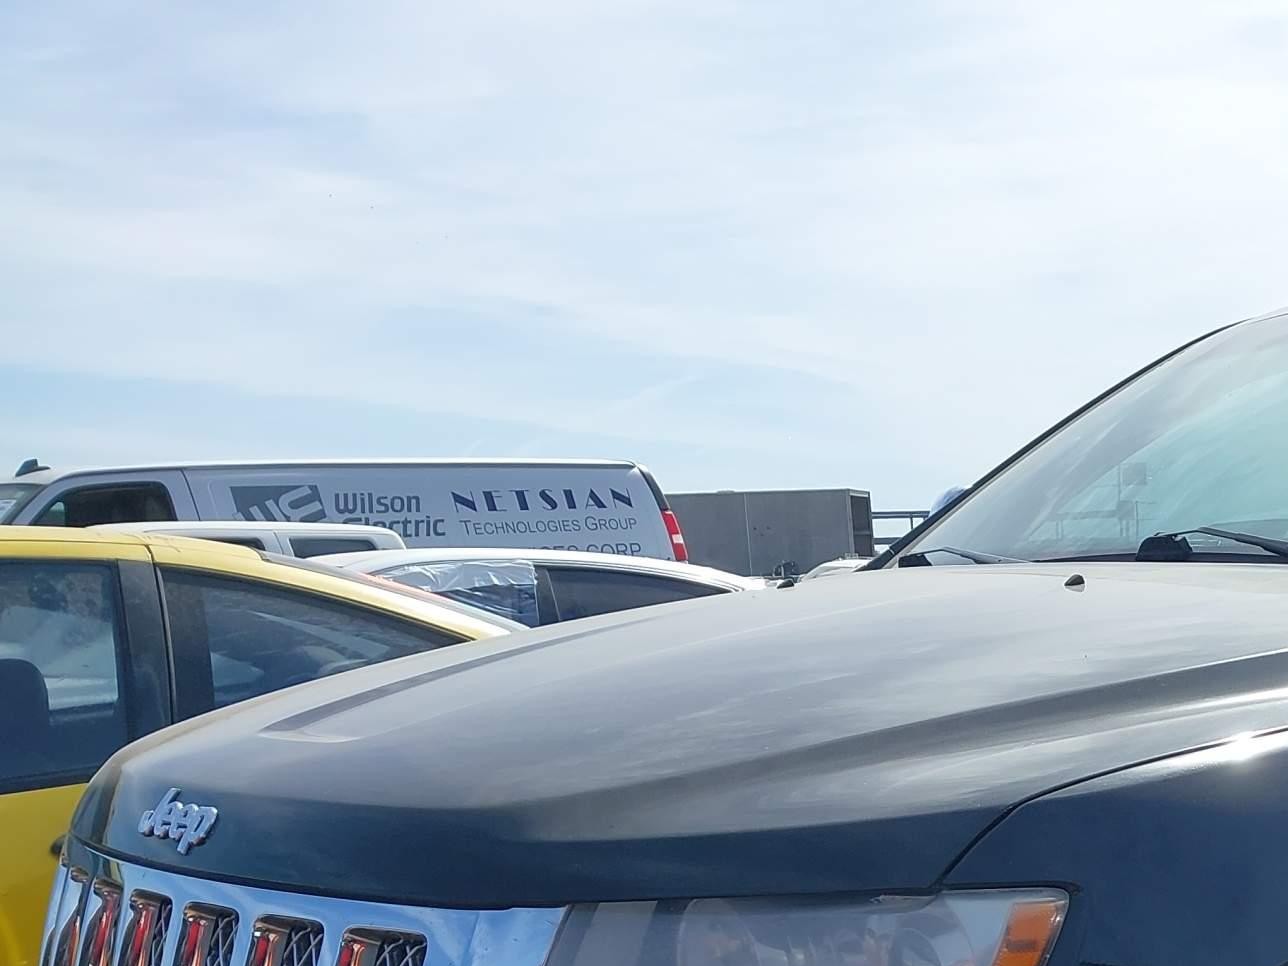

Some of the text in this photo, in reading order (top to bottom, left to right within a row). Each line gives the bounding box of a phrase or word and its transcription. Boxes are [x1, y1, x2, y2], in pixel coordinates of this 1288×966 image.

[334, 492, 421, 514] Wilson
[451, 487, 634, 513] NETSIAN
[459, 515, 637, 537] TECHNOLOGIES GROUP
[138, 788, 218, 855] Jeep
